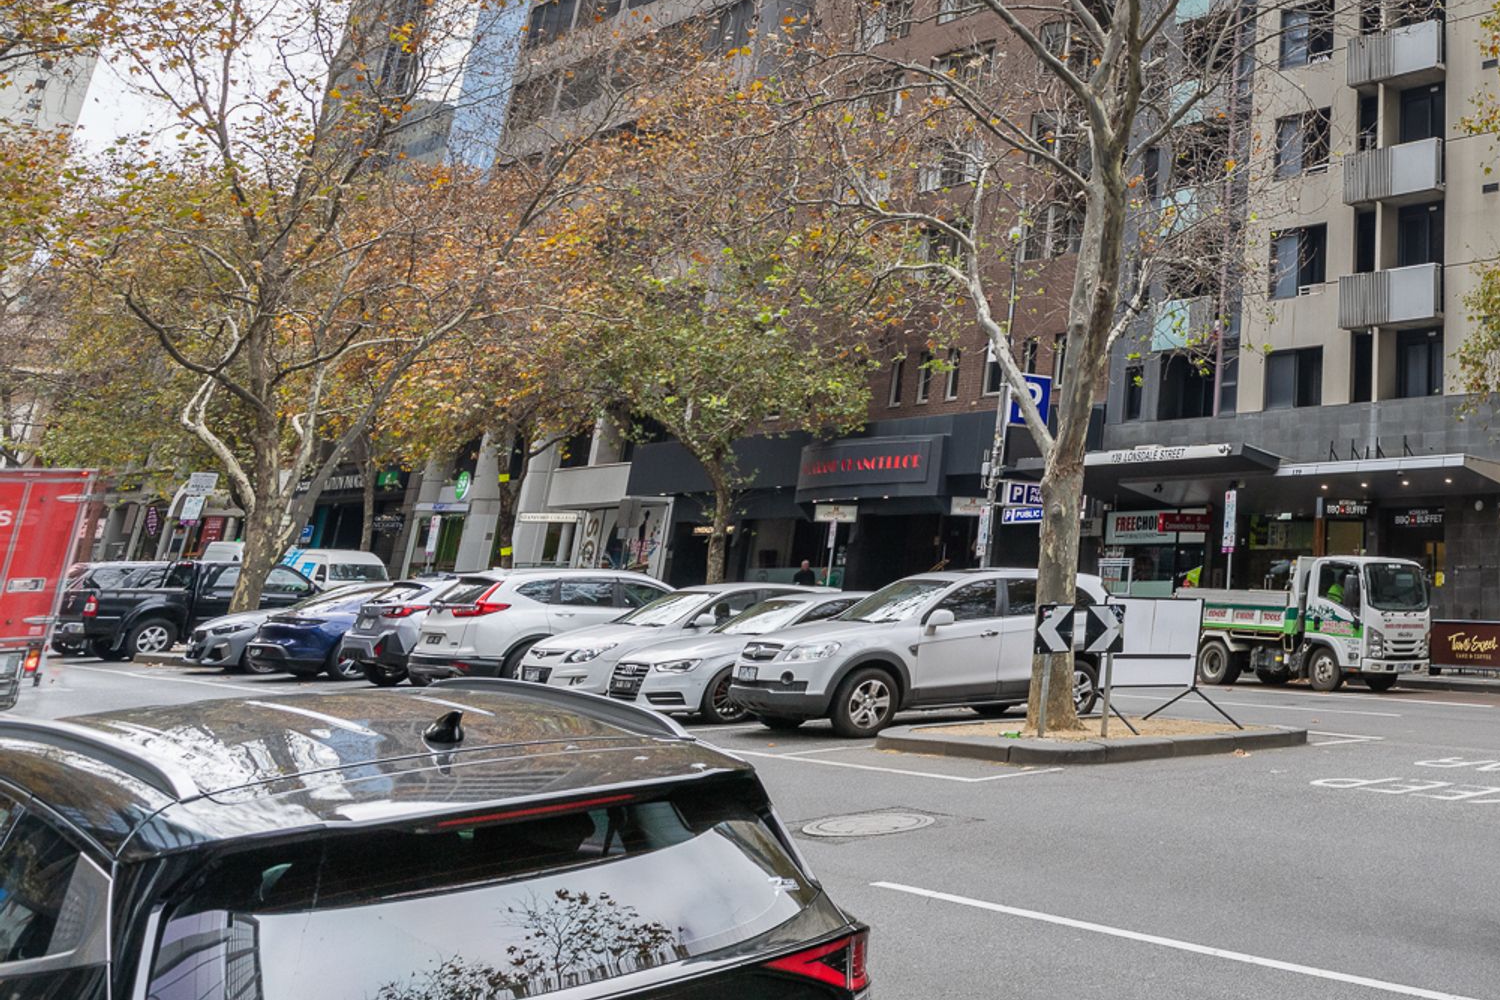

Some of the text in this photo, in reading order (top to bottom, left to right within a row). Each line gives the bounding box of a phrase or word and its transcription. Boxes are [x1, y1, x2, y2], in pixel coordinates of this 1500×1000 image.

[1124, 450, 1158, 462] LONSDALE
[1160, 448, 1186, 459] STREET
[1013, 486, 1023, 500] P
[1015, 509, 1041, 518] PUBLIC
